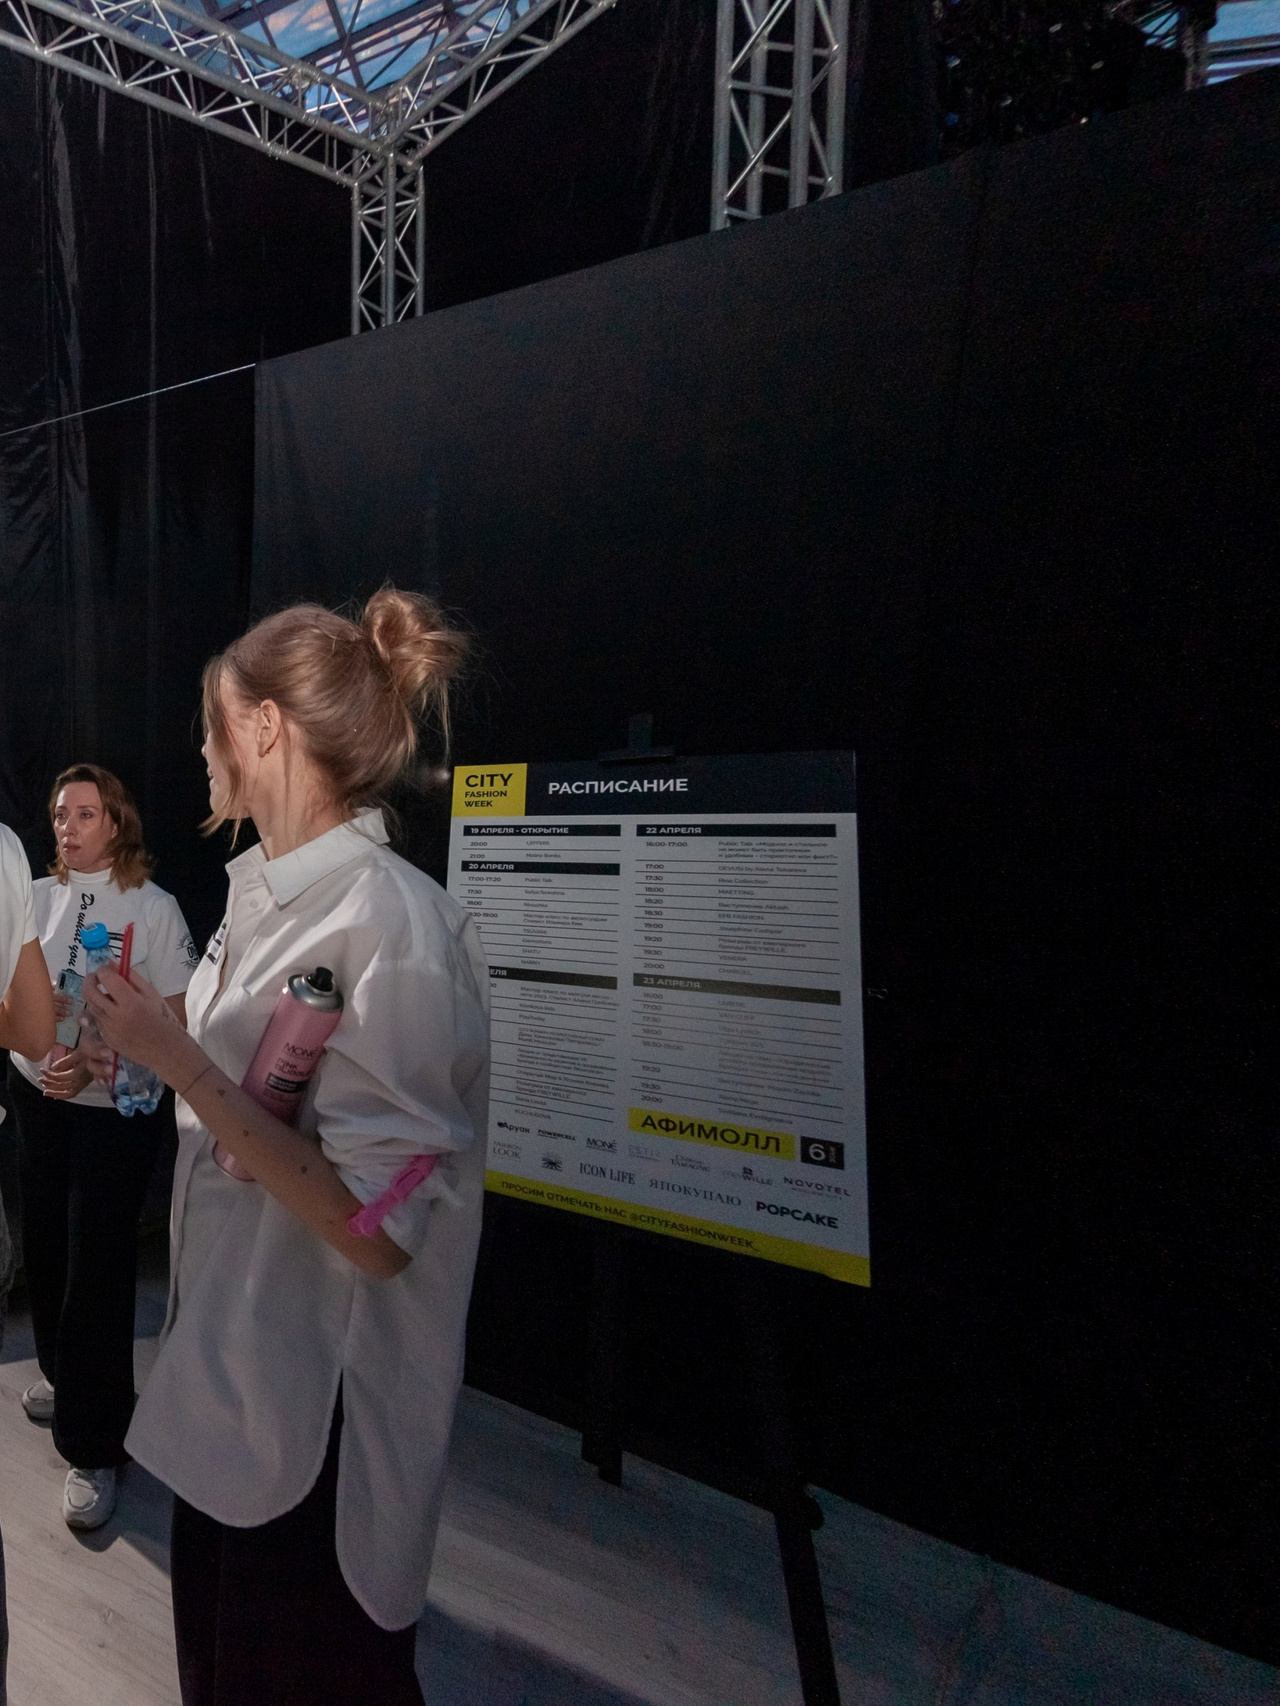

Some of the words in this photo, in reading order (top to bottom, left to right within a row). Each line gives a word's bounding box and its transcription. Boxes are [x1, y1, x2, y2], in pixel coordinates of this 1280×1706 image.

[465, 773, 514, 788] CITY
[548, 778, 688, 794] РАСПИСАНИЕ
[464, 790, 508, 798] FASHION
[464, 800, 493, 808] WEEK
[480, 863, 514, 871] АПРЕЛЯ
[80, 892, 95, 910] Do
[73, 912, 86, 944] what
[68, 944, 79, 967] you
[643, 962, 665, 970] 20:00
[642, 976, 655, 985] 23
[657, 978, 701, 988] АПРЕЛЯ
[641, 1114, 780, 1153] АФИМОЛЛ
[493, 1147, 521, 1159] LOOK
[809, 1143, 826, 1161] 6
[579, 1162, 606, 1179] ICON
[610, 1168, 636, 1185] LIFE
[649, 1179, 742, 1206] ЯПОКУПАЮ
[783, 1176, 852, 1197] NOVOTEL
[501, 1181, 544, 1198] ПРОСИМ
[546, 1192, 602, 1212] ОТМЕЧАТЬ
[604, 1206, 627, 1219] НАС
[756, 1201, 839, 1229] POPCAKE
